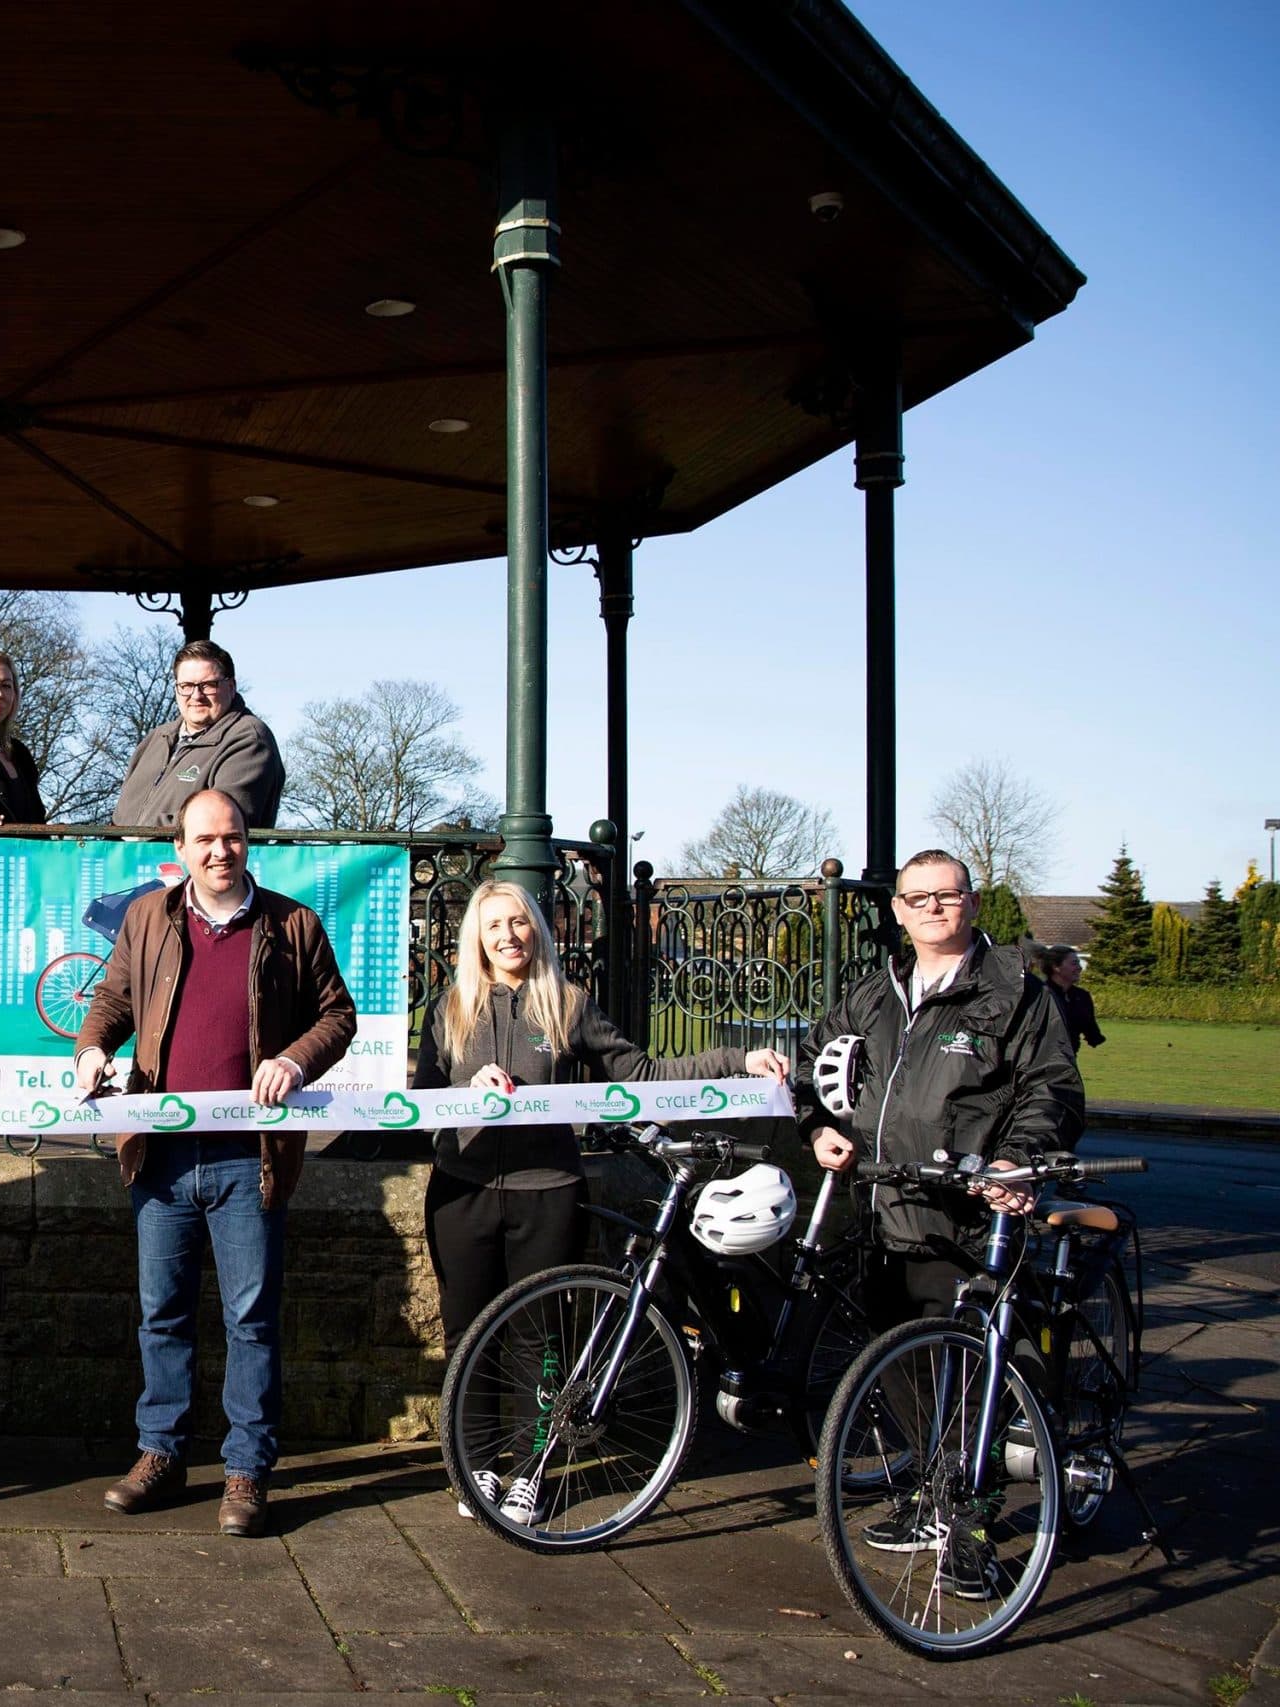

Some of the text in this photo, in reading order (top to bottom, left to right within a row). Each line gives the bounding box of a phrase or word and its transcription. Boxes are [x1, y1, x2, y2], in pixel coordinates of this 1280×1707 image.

[350, 1040, 394, 1056] CARE
[16, 1070, 52, 1088] Tel.
[435, 1099, 551, 1117] CYCLE 2 CARE
[575, 1099, 588, 1112] My
[589, 1099, 626, 1109] Homecare
[655, 1093, 768, 1109] CYCLE 2 CARE
[37, 1110, 46, 1123] 2
[63, 1109, 102, 1123] CARE
[127, 1109, 141, 1120] My
[143, 1109, 181, 1118] Homecare
[211, 1105, 329, 1120] CYCLE 2 CARE
[353, 1106, 367, 1119] My
[368, 1106, 405, 1116] Homecare
